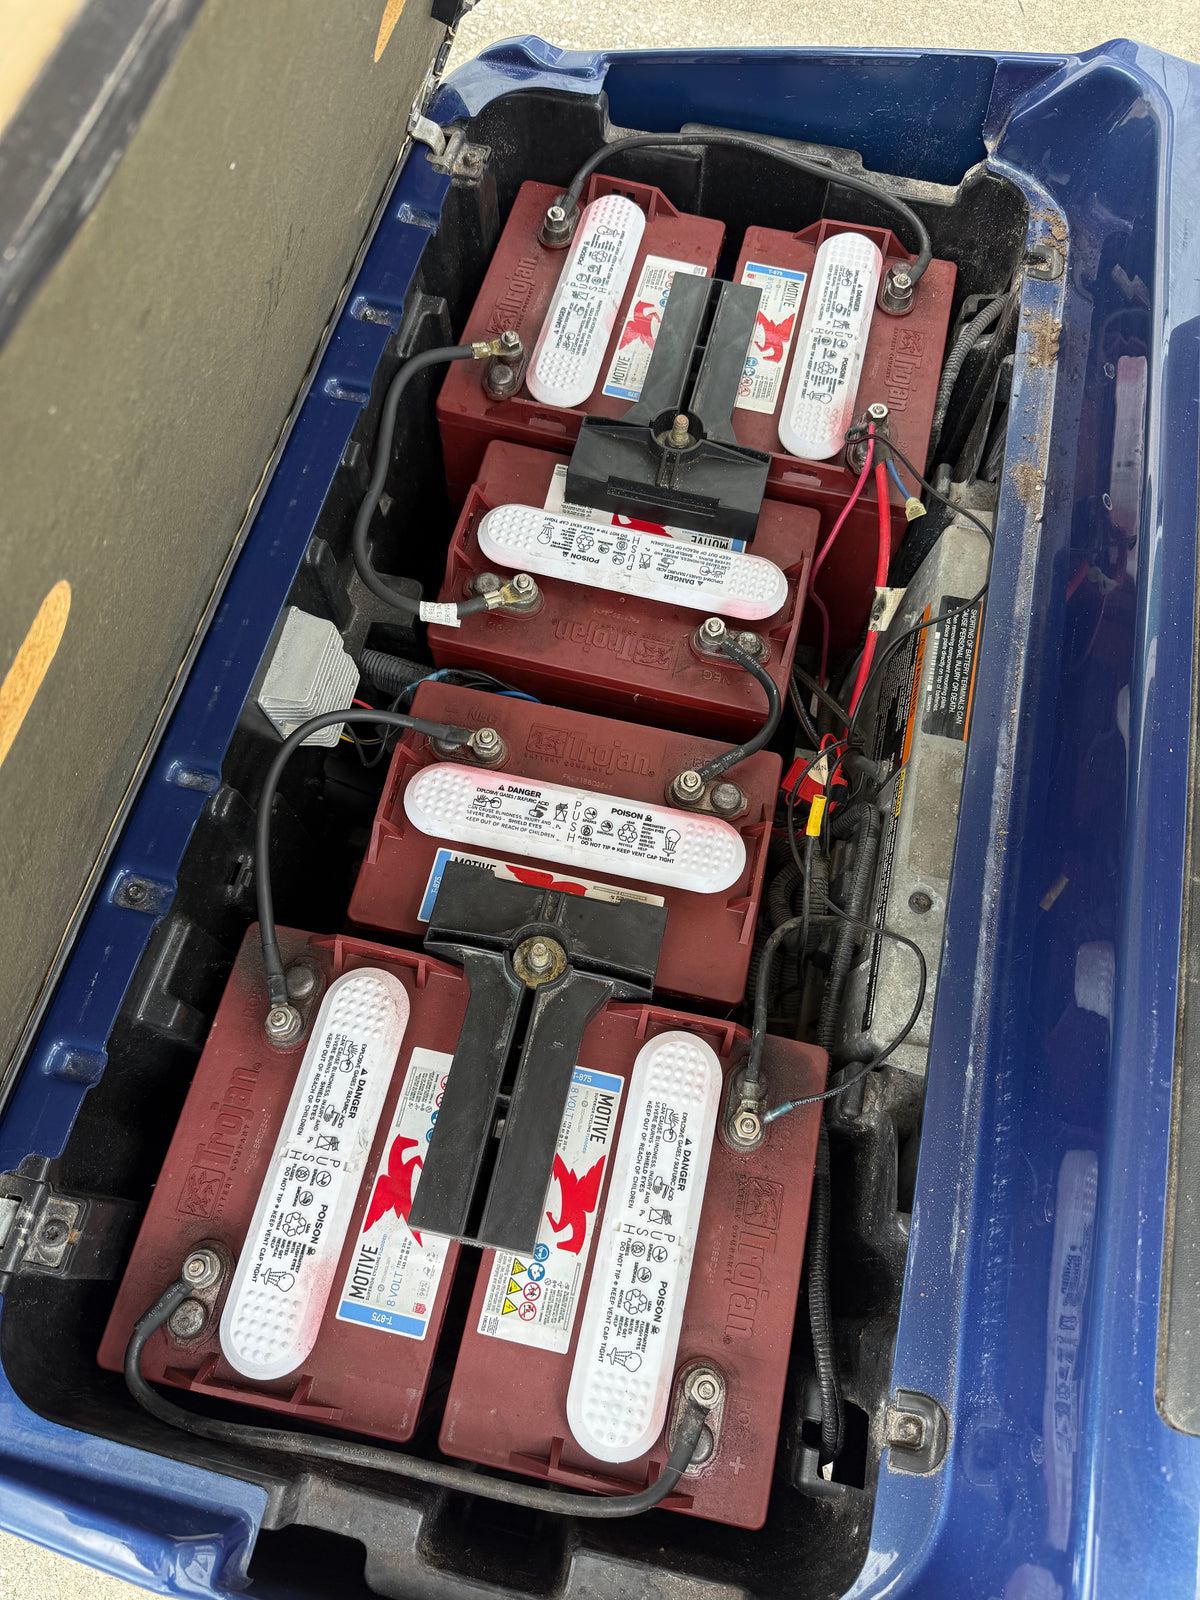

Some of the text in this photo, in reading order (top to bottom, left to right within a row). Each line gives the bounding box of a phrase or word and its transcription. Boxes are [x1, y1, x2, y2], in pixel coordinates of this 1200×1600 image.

[577, 245, 588, 265] POISON
[496, 258, 538, 313] Trojan
[784, 281, 800, 308] MOTIVE
[853, 289, 862, 311] DANGER
[554, 305, 567, 328] DANGER
[611, 356, 630, 384] MOTIVE
[838, 357, 848, 379] POISON
[884, 355, 922, 411] Trojan
[570, 552, 599, 563] POISON
[626, 536, 639, 570] PUSH
[663, 573, 694, 584] DANGER
[555, 620, 637, 662] Trojan
[948, 624, 957, 645] removing
[955, 627, 966, 659] PERSONAL
[938, 650, 946, 667] directly
[943, 646, 953, 672] component
[953, 659, 961, 679] INJURY
[955, 608, 977, 724] SHORTING OF BATTERY TERMINALS CAN
[941, 673, 950, 696] mounting
[951, 681, 958, 691] OR
[948, 692, 957, 713] DEATH.
[568, 732, 650, 776] Trojan
[507, 785, 541, 798] DANGER
[566, 800, 582, 842] PUSH
[610, 807, 643, 820] POISON
[528, 828, 554, 838] CHILDREN
[333, 1046, 343, 1065] CAUSE
[296, 1032, 332, 1136] KEEP OUT OF REACH OF CHILDREN
[309, 1033, 340, 1120] SEVERE BURNS SHIELD EYES
[572, 1072, 592, 1083] T-875
[316, 1098, 326, 1118] INJURY
[347, 1078, 365, 1119] DANGER
[564, 1094, 577, 1119] VOLT
[590, 1092, 598, 1113] SUPERIOR
[644, 1100, 652, 1116] KEEP
[192, 1068, 259, 1164] Trojan
[589, 1093, 614, 1144] MOTIVE
[651, 1101, 659, 1122] SEVERE
[640, 1132, 646, 1141] OF
[289, 1147, 340, 1172] PUSH
[635, 1142, 644, 1164] REACH
[642, 1151, 650, 1174] SHIELD
[283, 1166, 290, 1176] DO
[633, 1165, 640, 1174] OF
[676, 1149, 691, 1191] DANGER
[279, 1177, 287, 1190] NOT
[627, 1176, 638, 1208] CHILDREN
[638, 1175, 646, 1192] EYES
[267, 1210, 277, 1228] KEEP
[309, 1203, 327, 1244] POISON
[262, 1229, 271, 1246] VENT
[622, 1223, 675, 1242] PUSH
[257, 1247, 266, 1261] CAP
[619, 1241, 626, 1251] DO
[251, 1262, 261, 1282] TIGHT
[348, 1243, 379, 1300] MOTIVE
[364, 1277, 375, 1300] SUPERIOR
[371, 1256, 381, 1276] CYCLING
[387, 1270, 404, 1298] VOLT
[724, 1231, 777, 1338] Trojan
[385, 1298, 395, 1307] 8
[608, 1287, 616, 1305] KEEP
[653, 1280, 667, 1322] POISON
[372, 1312, 392, 1325] T-875
[604, 1306, 613, 1324] VENT
[601, 1326, 609, 1340] CAP
[597, 1341, 606, 1362] TIGHT
